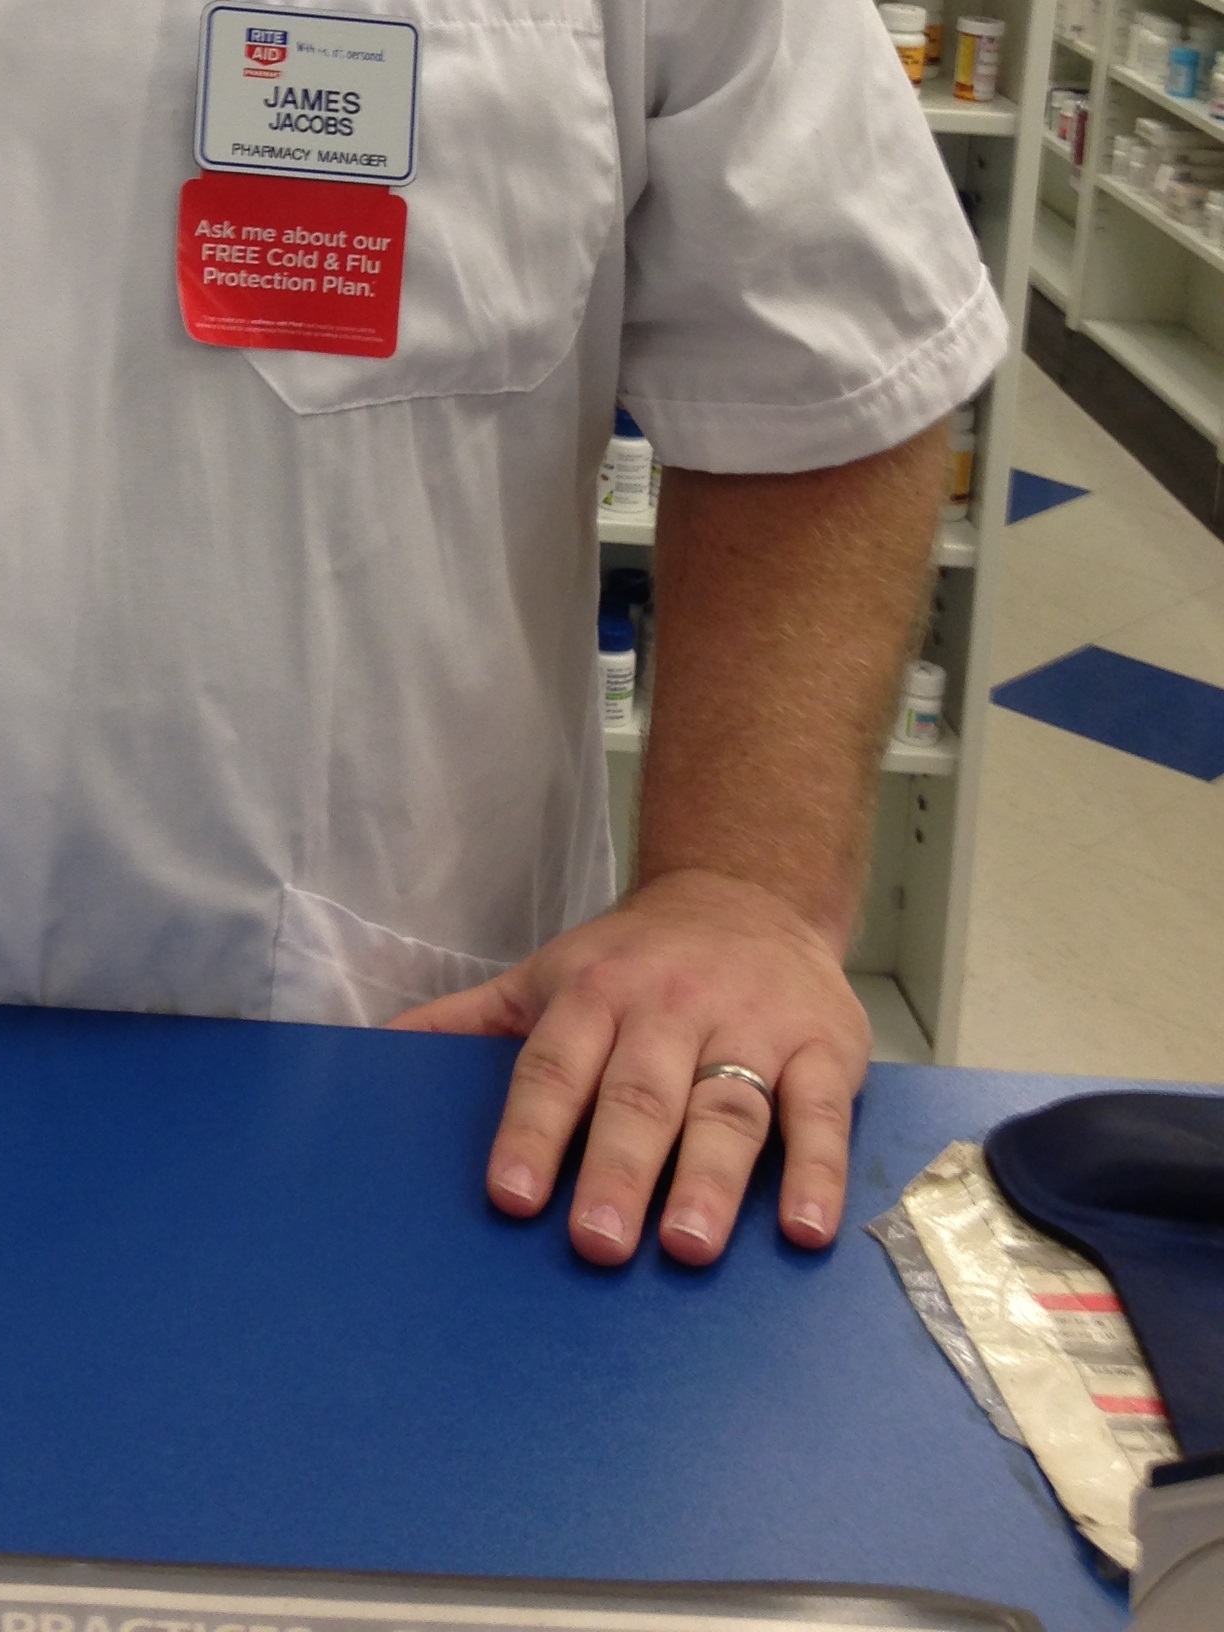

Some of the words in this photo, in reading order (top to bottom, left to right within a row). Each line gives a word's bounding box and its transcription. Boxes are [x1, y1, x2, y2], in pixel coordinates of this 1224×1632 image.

[250, 29, 285, 44] RITE
[251, 47, 281, 61] AID
[263, 86, 361, 115] JAMES
[268, 112, 354, 137] JACOBS
[231, 143, 311, 161] PHARMACY
[317, 150, 389, 168] MANAGER
[194, 219, 237, 240] Ask
[241, 225, 277, 243] me
[282, 226, 349, 248] about
[352, 235, 392, 252] our
[201, 243, 262, 265] FREE
[266, 248, 320, 270] Cold
[323, 252, 340, 272] &
[346, 254, 381, 275] Flu
[203, 267, 317, 293] Protection
[322, 275, 376, 298] Plan.
